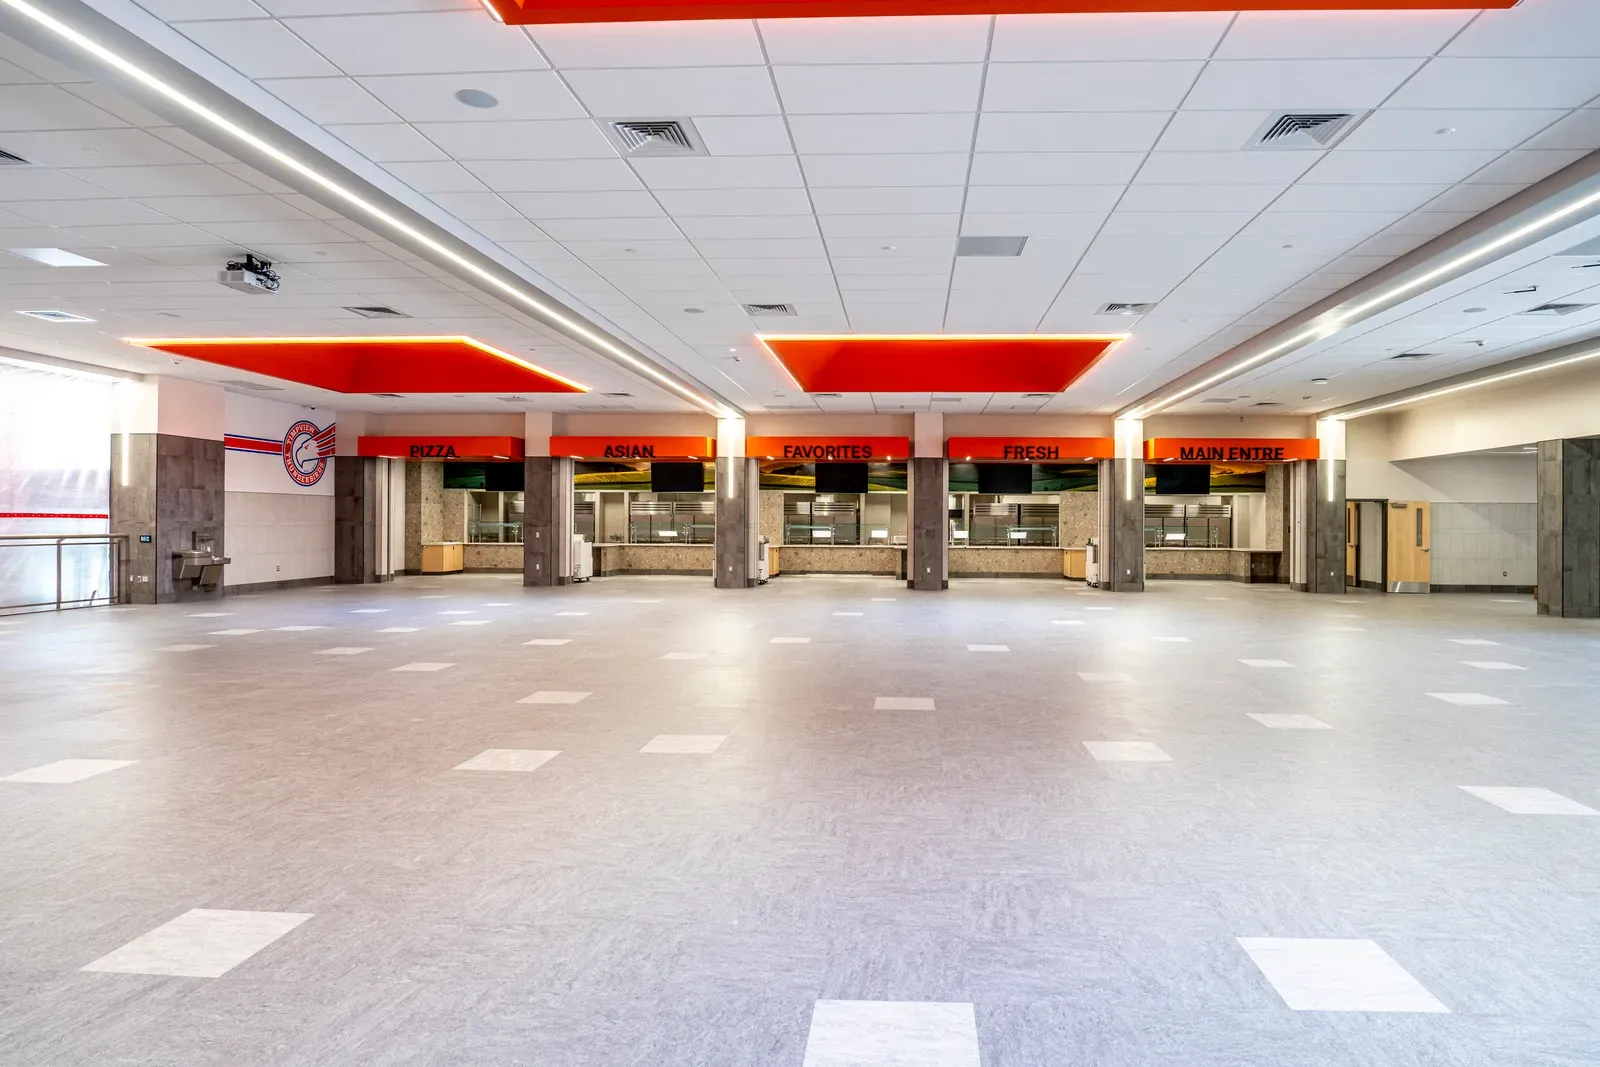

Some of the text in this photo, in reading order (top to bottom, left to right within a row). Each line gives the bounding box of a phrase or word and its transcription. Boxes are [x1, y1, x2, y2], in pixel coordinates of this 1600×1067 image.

[287, 424, 315, 444] TIMPVIEW
[410, 445, 460, 458] PIZZA
[604, 445, 656, 458] ASIAN
[783, 445, 872, 458] FAVORITES
[1003, 445, 1059, 459] FRESH
[1180, 447, 1284, 460] MAIN ENTRE
[286, 452, 324, 483] THUNDERBIRDS
